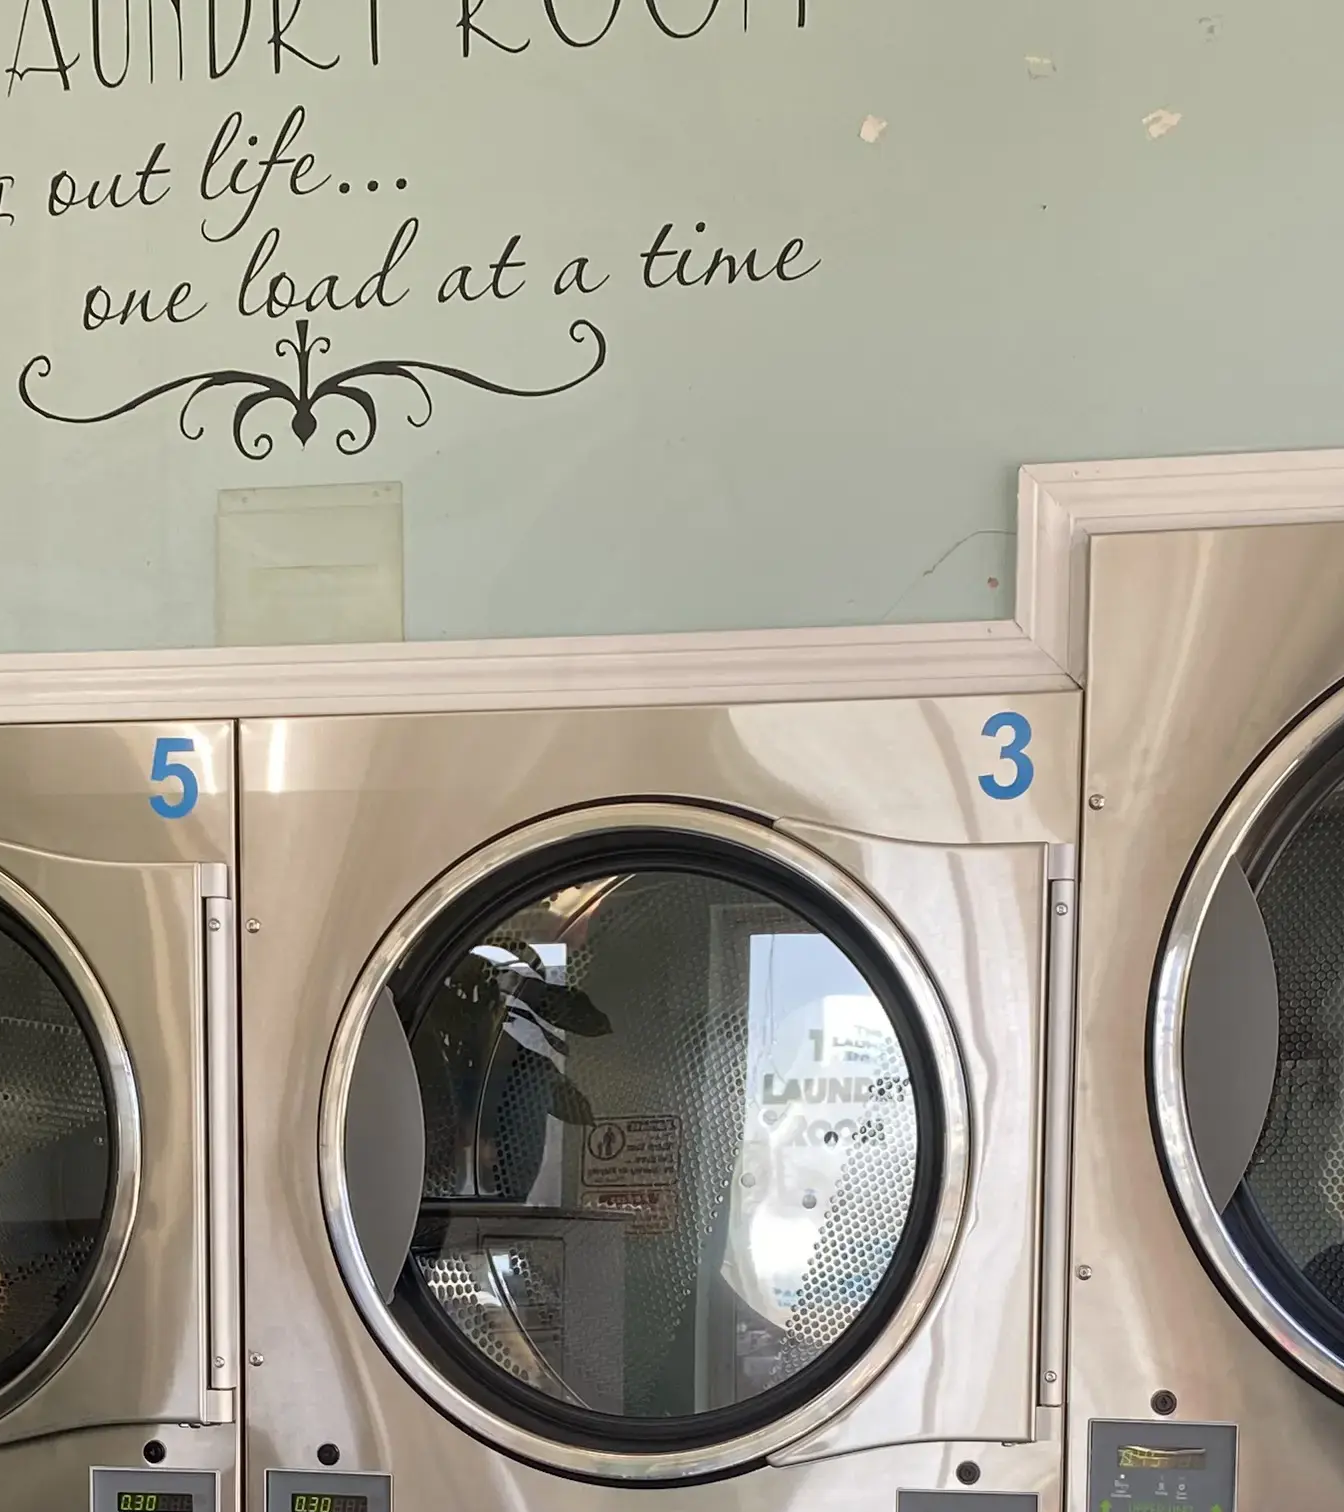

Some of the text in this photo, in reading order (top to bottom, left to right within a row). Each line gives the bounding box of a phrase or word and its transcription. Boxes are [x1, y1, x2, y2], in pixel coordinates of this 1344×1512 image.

[48, 142, 171, 217] out
[83, 216, 822, 331] one load at a time
[150, 738, 197, 819] 5
[981, 712, 1033, 799] 3
[763, 1074, 871, 1105] LAUND
[120, 1494, 157, 1511] 0.30
[294, 1495, 332, 1512] 0.30
